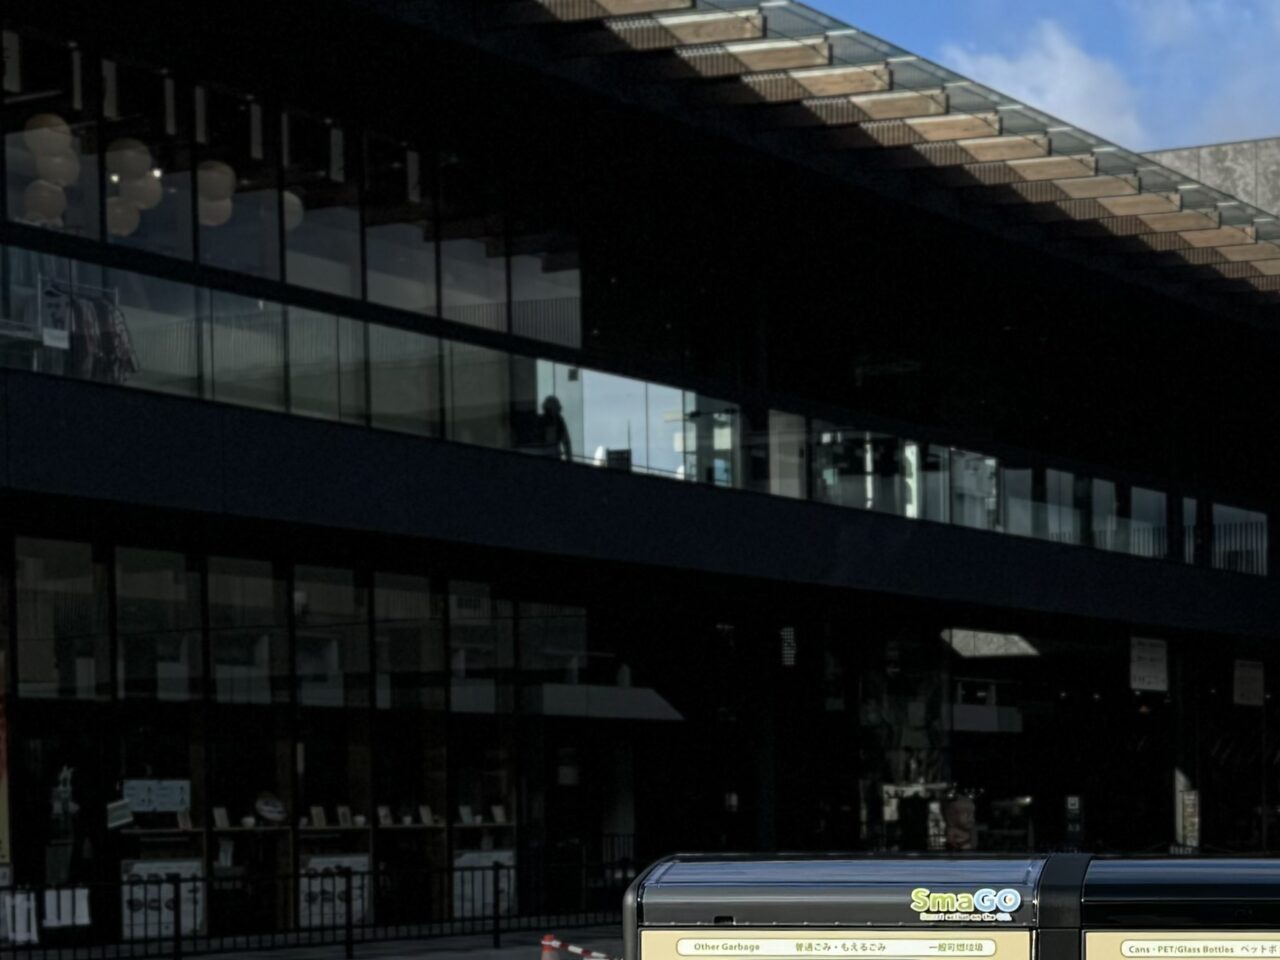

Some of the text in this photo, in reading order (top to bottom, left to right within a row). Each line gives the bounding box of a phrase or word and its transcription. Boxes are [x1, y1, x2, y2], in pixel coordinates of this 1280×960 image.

[911, 888, 1021, 912] SmaGO
[694, 943, 760, 953] Other Garbage
[1203, 945, 1234, 954] Bottles
